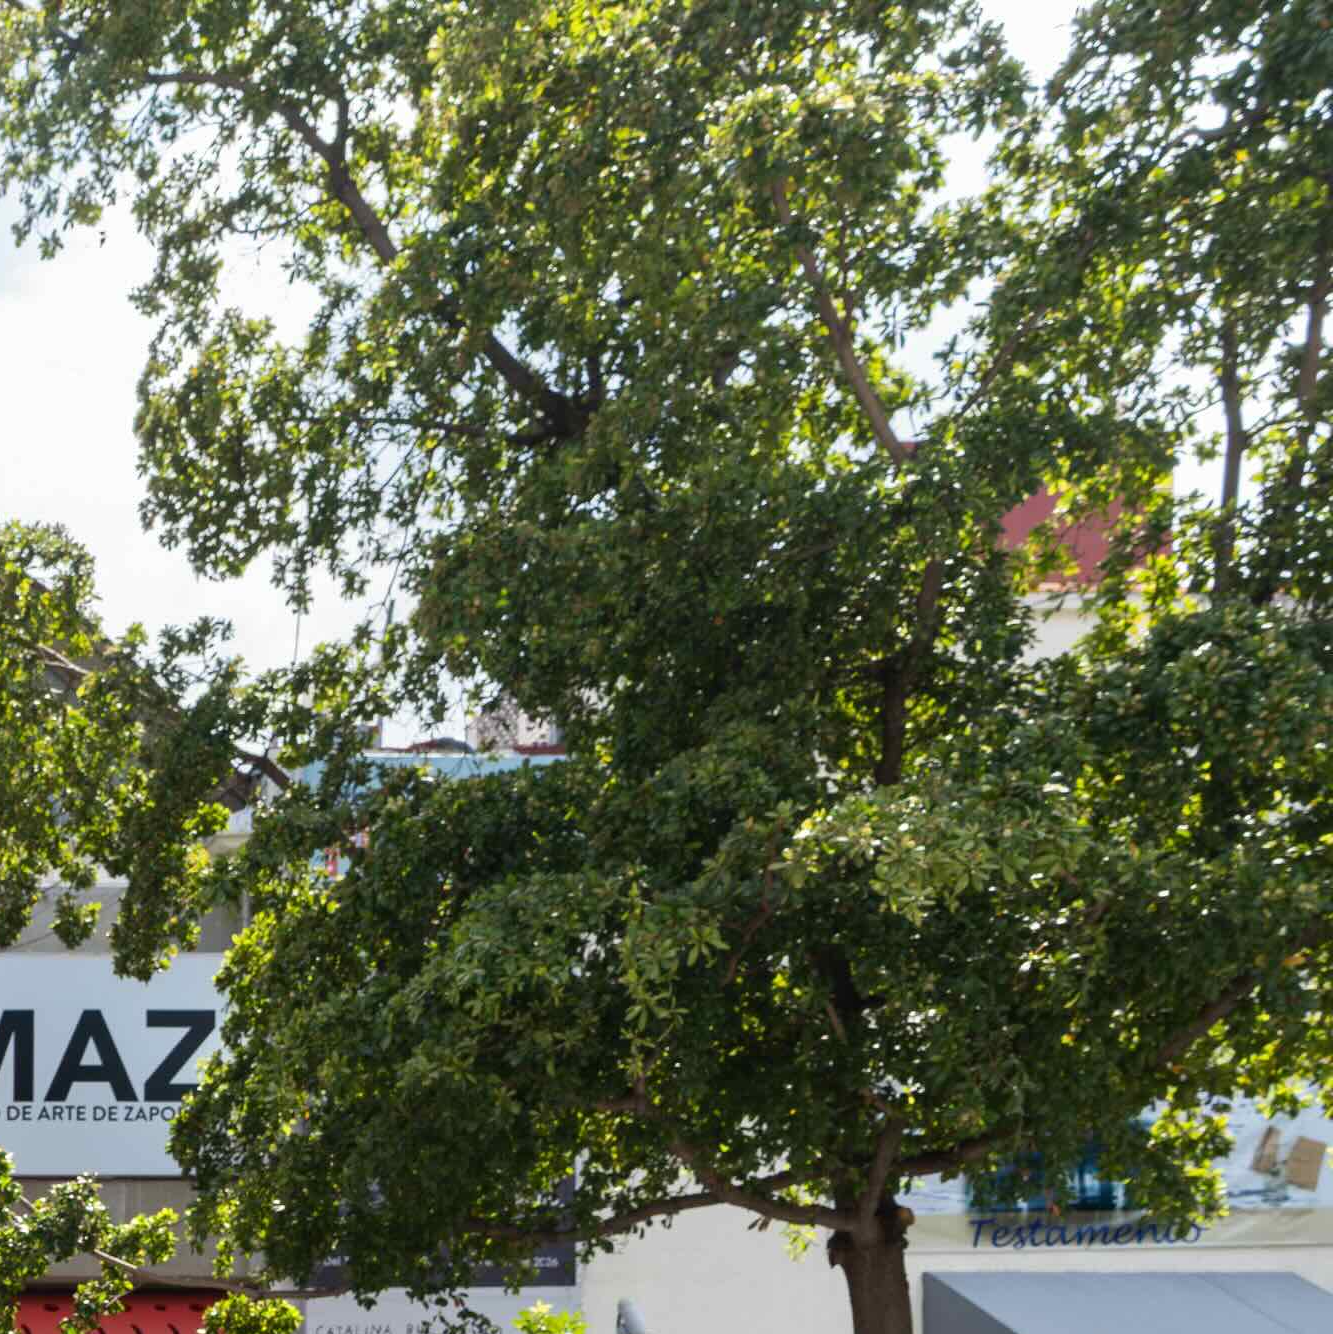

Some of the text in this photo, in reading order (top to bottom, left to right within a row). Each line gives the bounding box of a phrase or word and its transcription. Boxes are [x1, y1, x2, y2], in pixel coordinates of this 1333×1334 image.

[6, 1105, 33, 1121] DE
[38, 1105, 87, 1121] ARTE
[92, 1105, 119, 1122] DE
[123, 1105, 182, 1122] ZAPO
